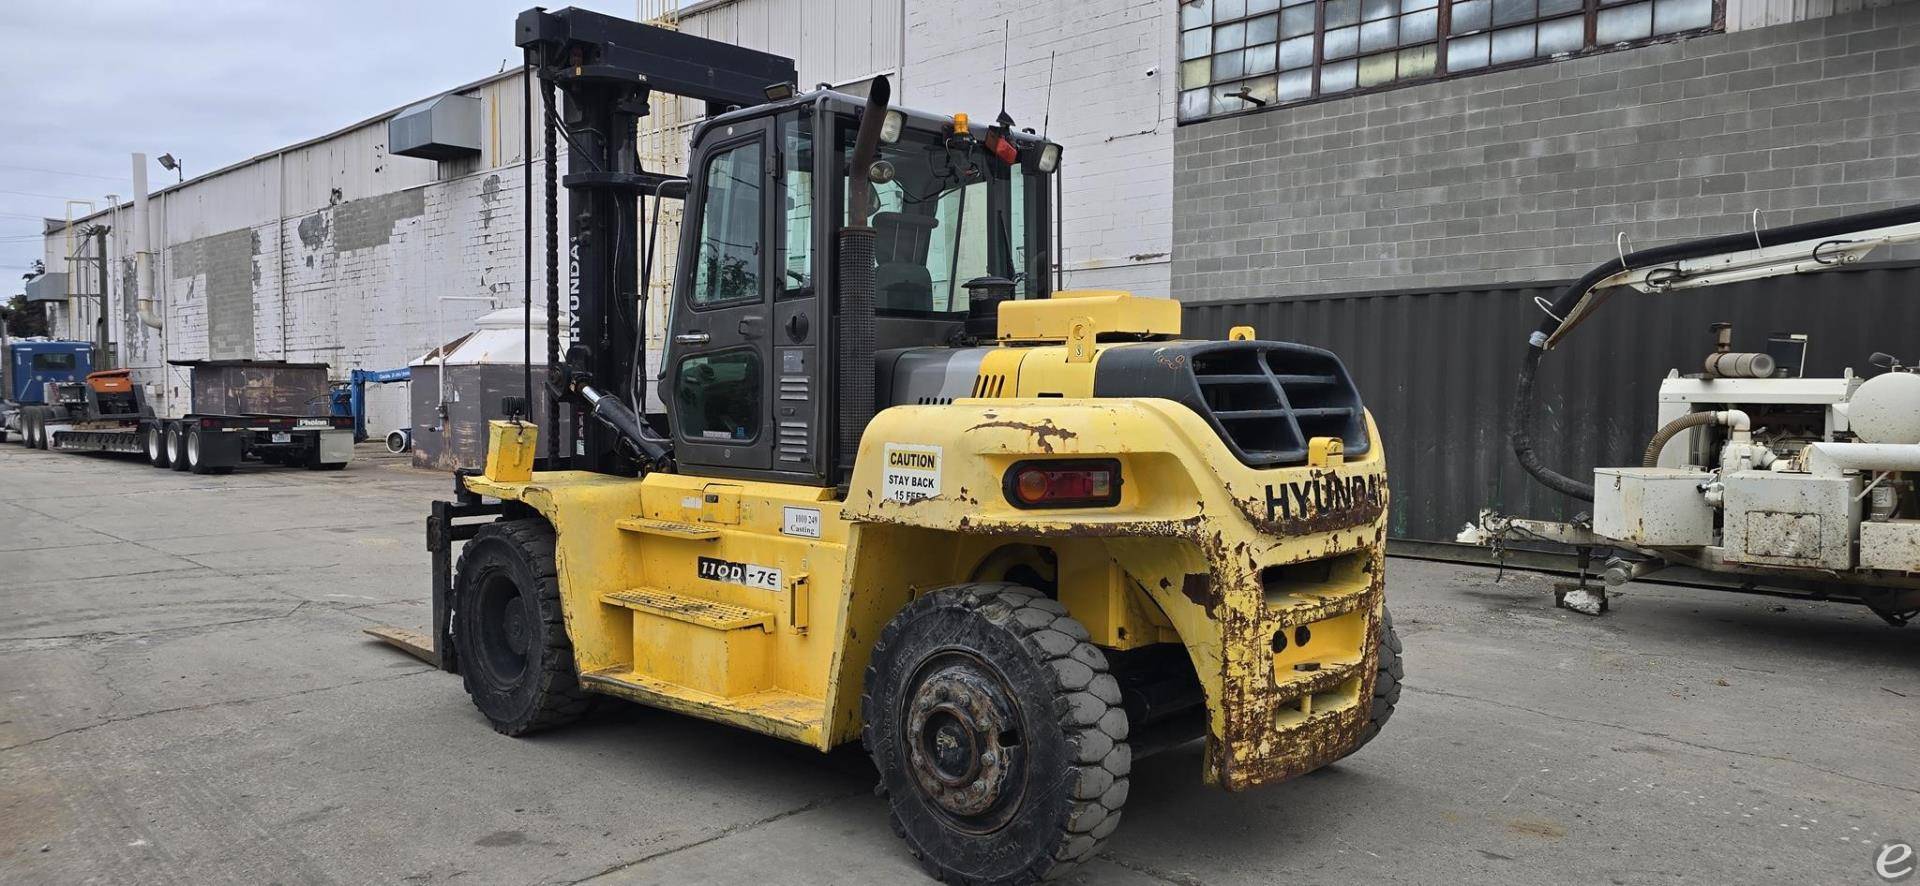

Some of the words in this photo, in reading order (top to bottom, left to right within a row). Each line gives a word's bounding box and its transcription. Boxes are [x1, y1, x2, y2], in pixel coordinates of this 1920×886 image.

[890, 452, 935, 468] CAUTION
[888, 474, 910, 486] STAY
[911, 476, 935, 489] BACK
[895, 490, 905, 501] 15
[790, 524, 815, 536] Casting
